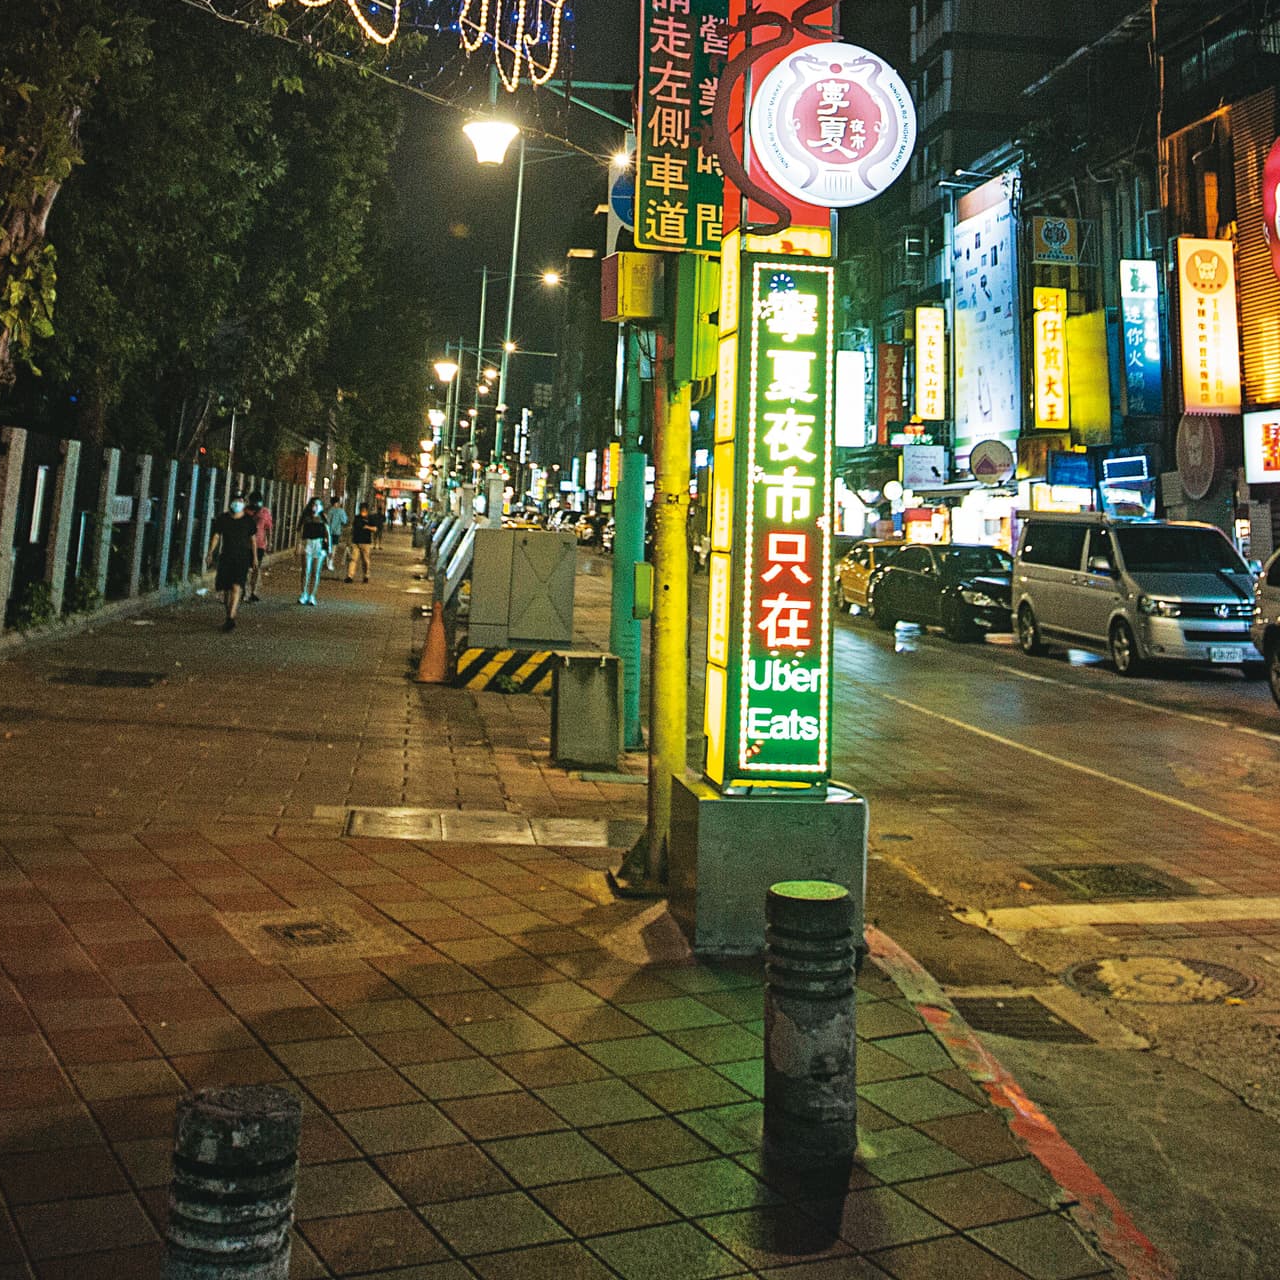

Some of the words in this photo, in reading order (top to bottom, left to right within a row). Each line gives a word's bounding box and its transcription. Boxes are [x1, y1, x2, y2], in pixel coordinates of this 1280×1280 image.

[806, 79, 859, 159] 寧夏
[883, 348, 899, 444] 嘉義火雞肉
[1039, 294, 1062, 423] 蚵仔煎大王
[748, 656, 821, 693] Uber
[746, 707, 821, 742] Eats
